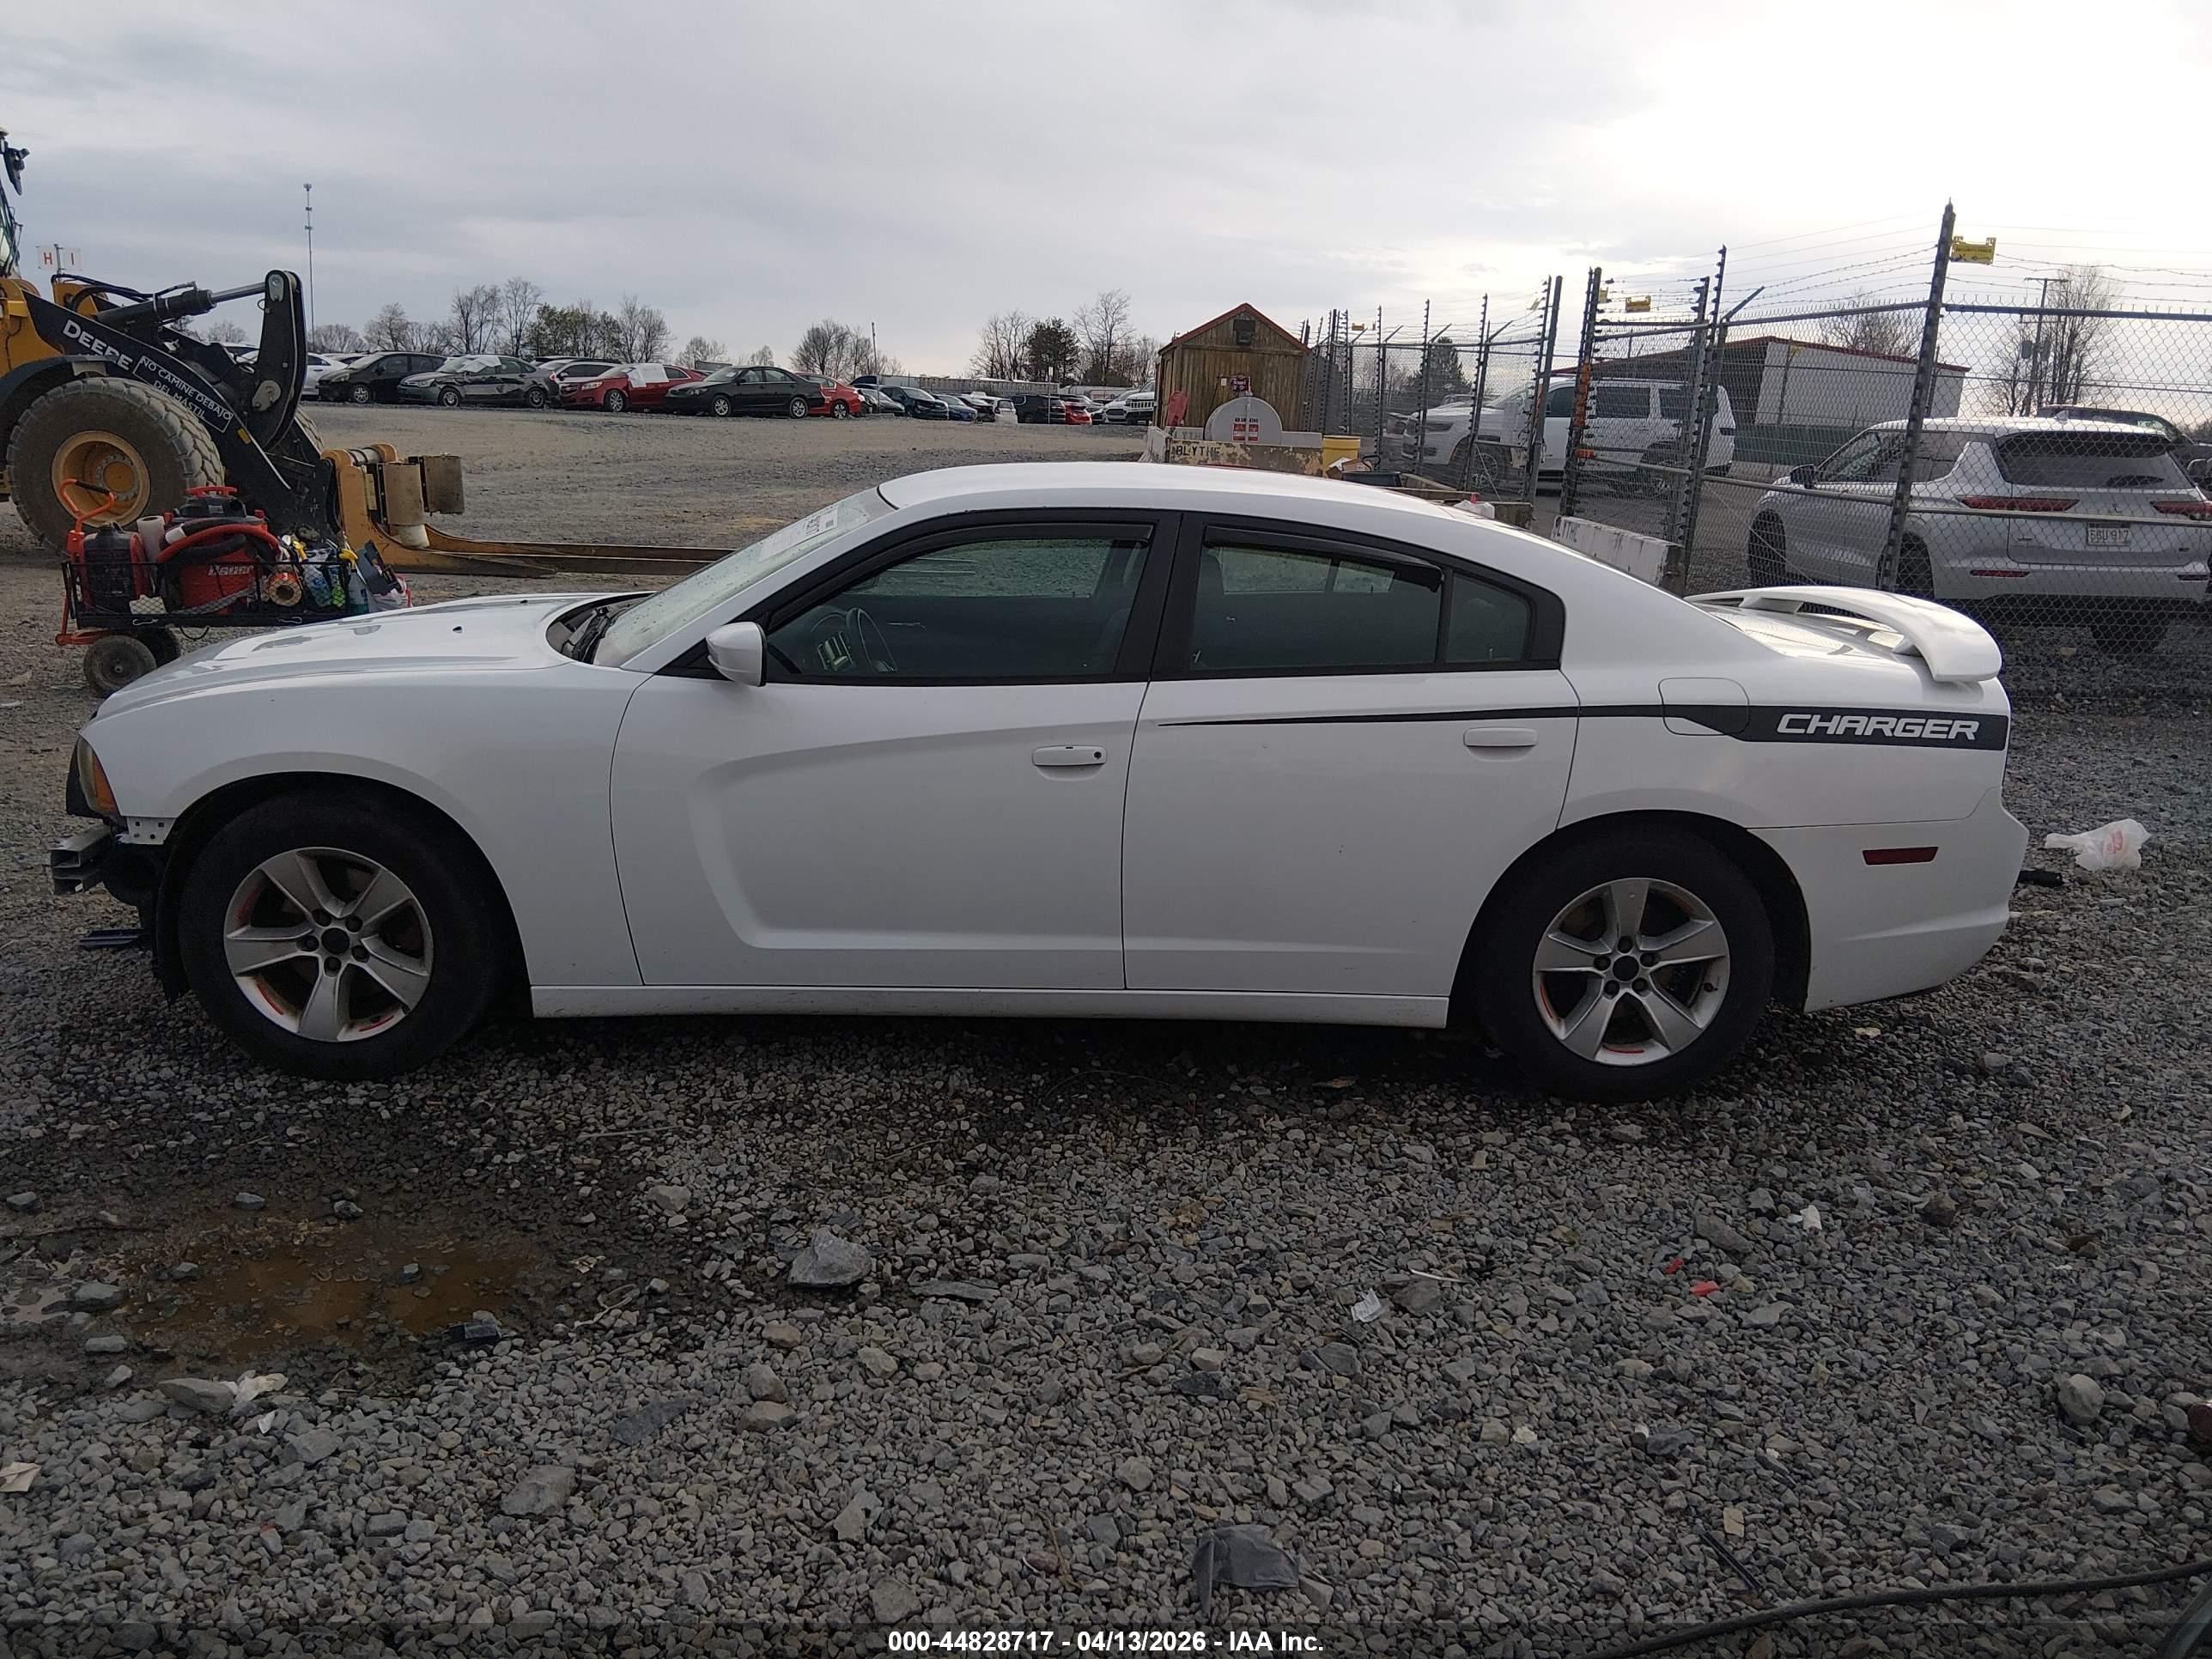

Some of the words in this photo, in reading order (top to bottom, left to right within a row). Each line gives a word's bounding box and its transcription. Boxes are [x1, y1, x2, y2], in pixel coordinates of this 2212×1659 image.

[44, 252, 52, 265] H
[141, 357, 156, 371] NO
[158, 369, 194, 398] CAMINE
[196, 393, 232, 420] DEBAJO
[154, 380, 170, 396] DEL
[1777, 714, 1979, 740] CHARGER
